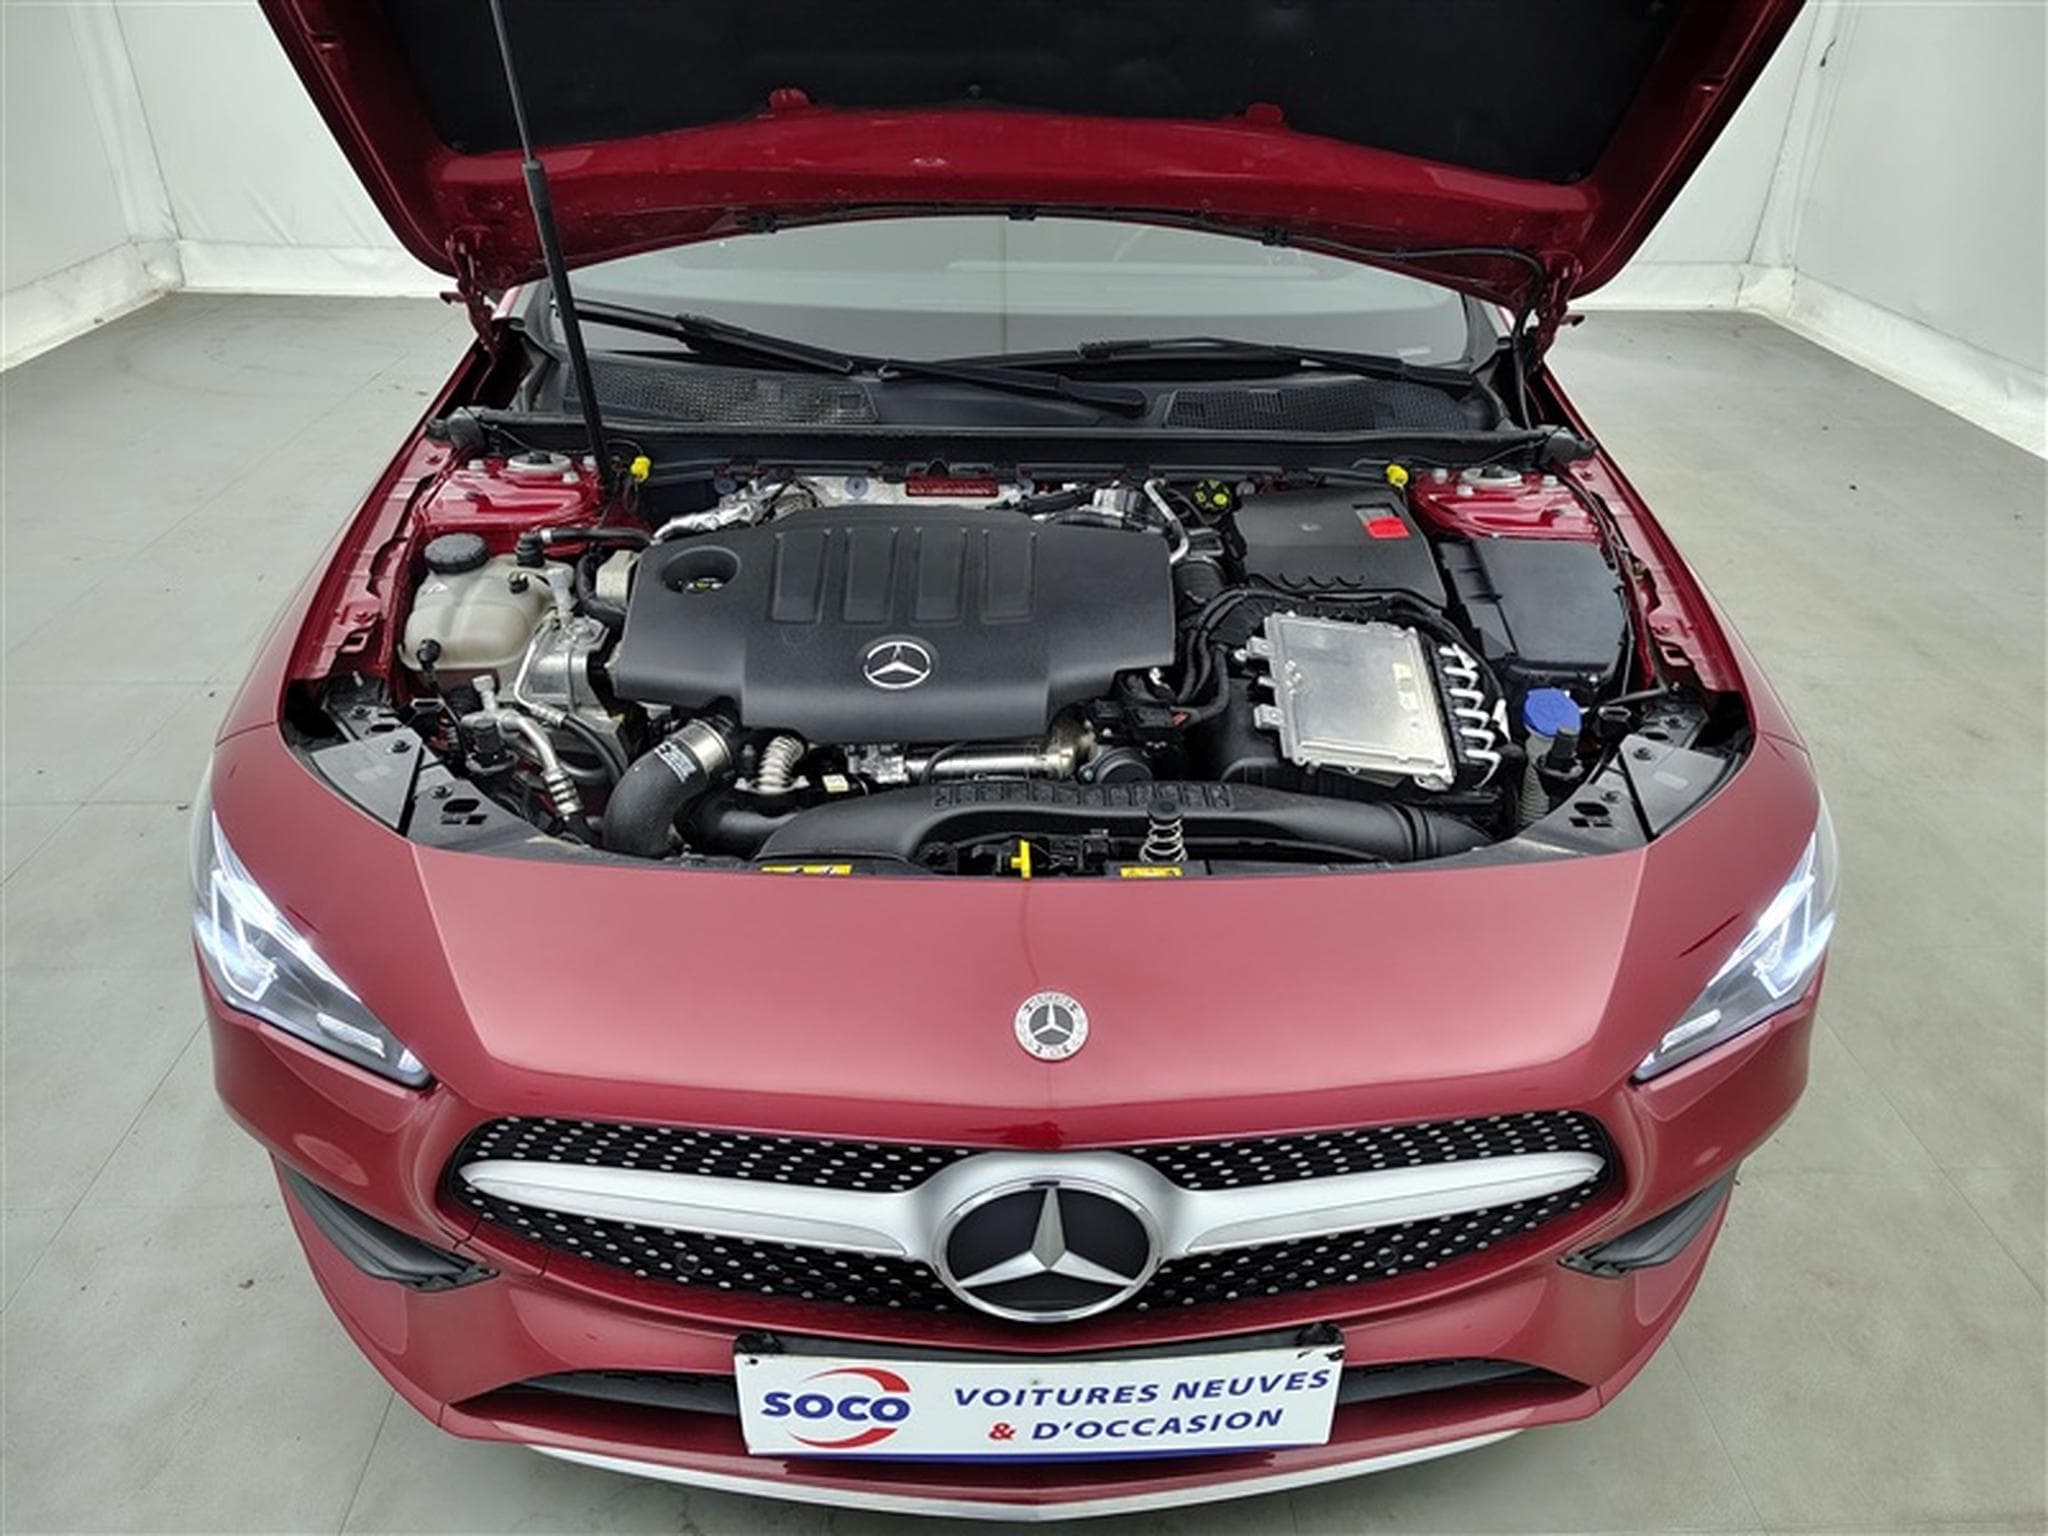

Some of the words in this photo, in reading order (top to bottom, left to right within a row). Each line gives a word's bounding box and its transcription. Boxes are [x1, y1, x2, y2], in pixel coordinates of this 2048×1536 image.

[954, 1384, 1160, 1407] VOITURES
[1172, 1369, 1331, 1401] NEUVES
[761, 1391, 911, 1423] SOCO
[988, 1422, 1017, 1441] &
[1032, 1408, 1284, 1441] D'OCCASION
